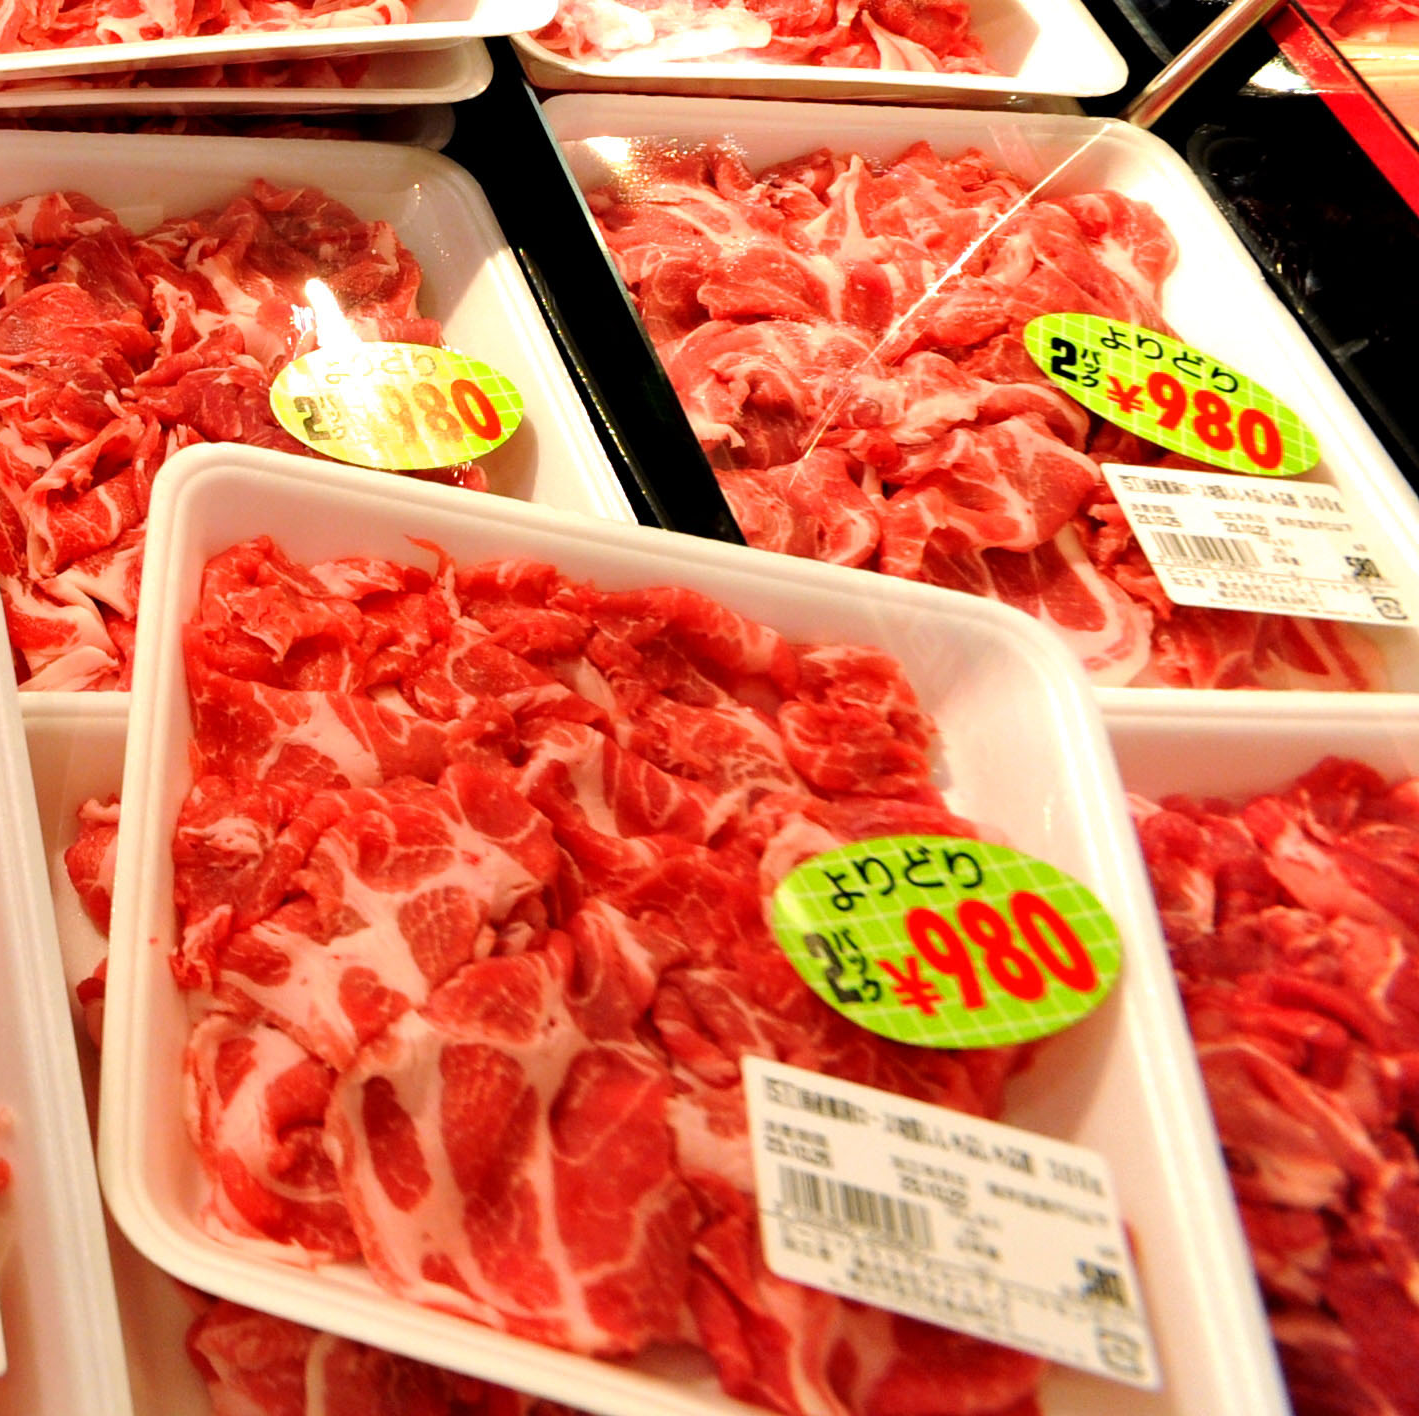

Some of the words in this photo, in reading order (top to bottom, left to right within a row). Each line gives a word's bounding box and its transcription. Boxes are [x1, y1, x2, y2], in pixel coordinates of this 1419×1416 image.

[1100, 325, 1239, 394] よりどり
[386, 379, 502, 444] 980
[823, 846, 984, 913] よりどり
